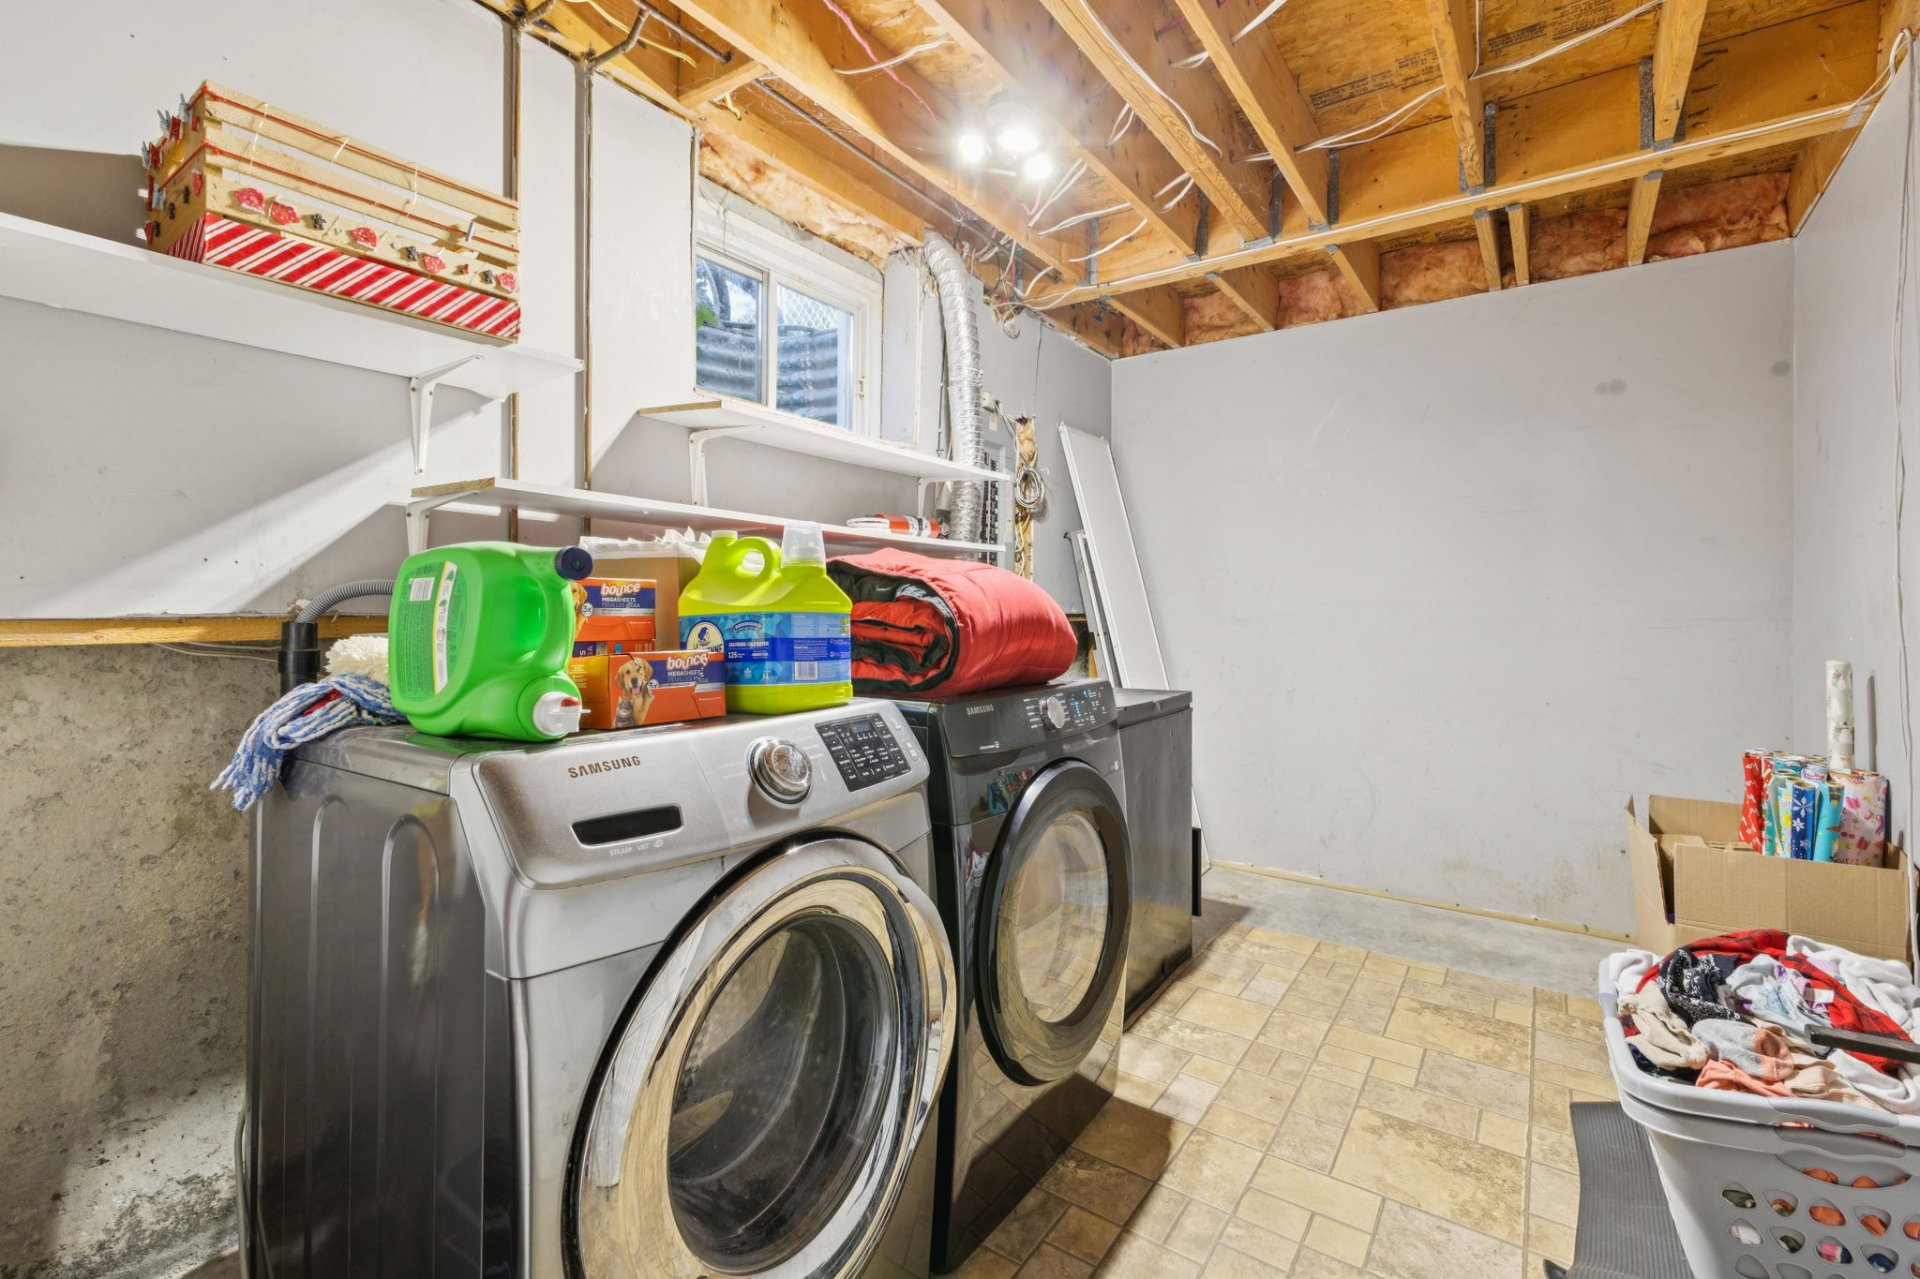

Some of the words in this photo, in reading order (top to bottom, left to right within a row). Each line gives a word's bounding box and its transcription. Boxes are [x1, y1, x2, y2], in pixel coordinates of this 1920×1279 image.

[601, 582, 641, 597] bounce
[666, 653, 708, 670] bounce
[967, 704, 994, 715] SAMSUNG
[568, 755, 641, 778] SAMSUNG
[609, 846, 632, 856] STEAM
